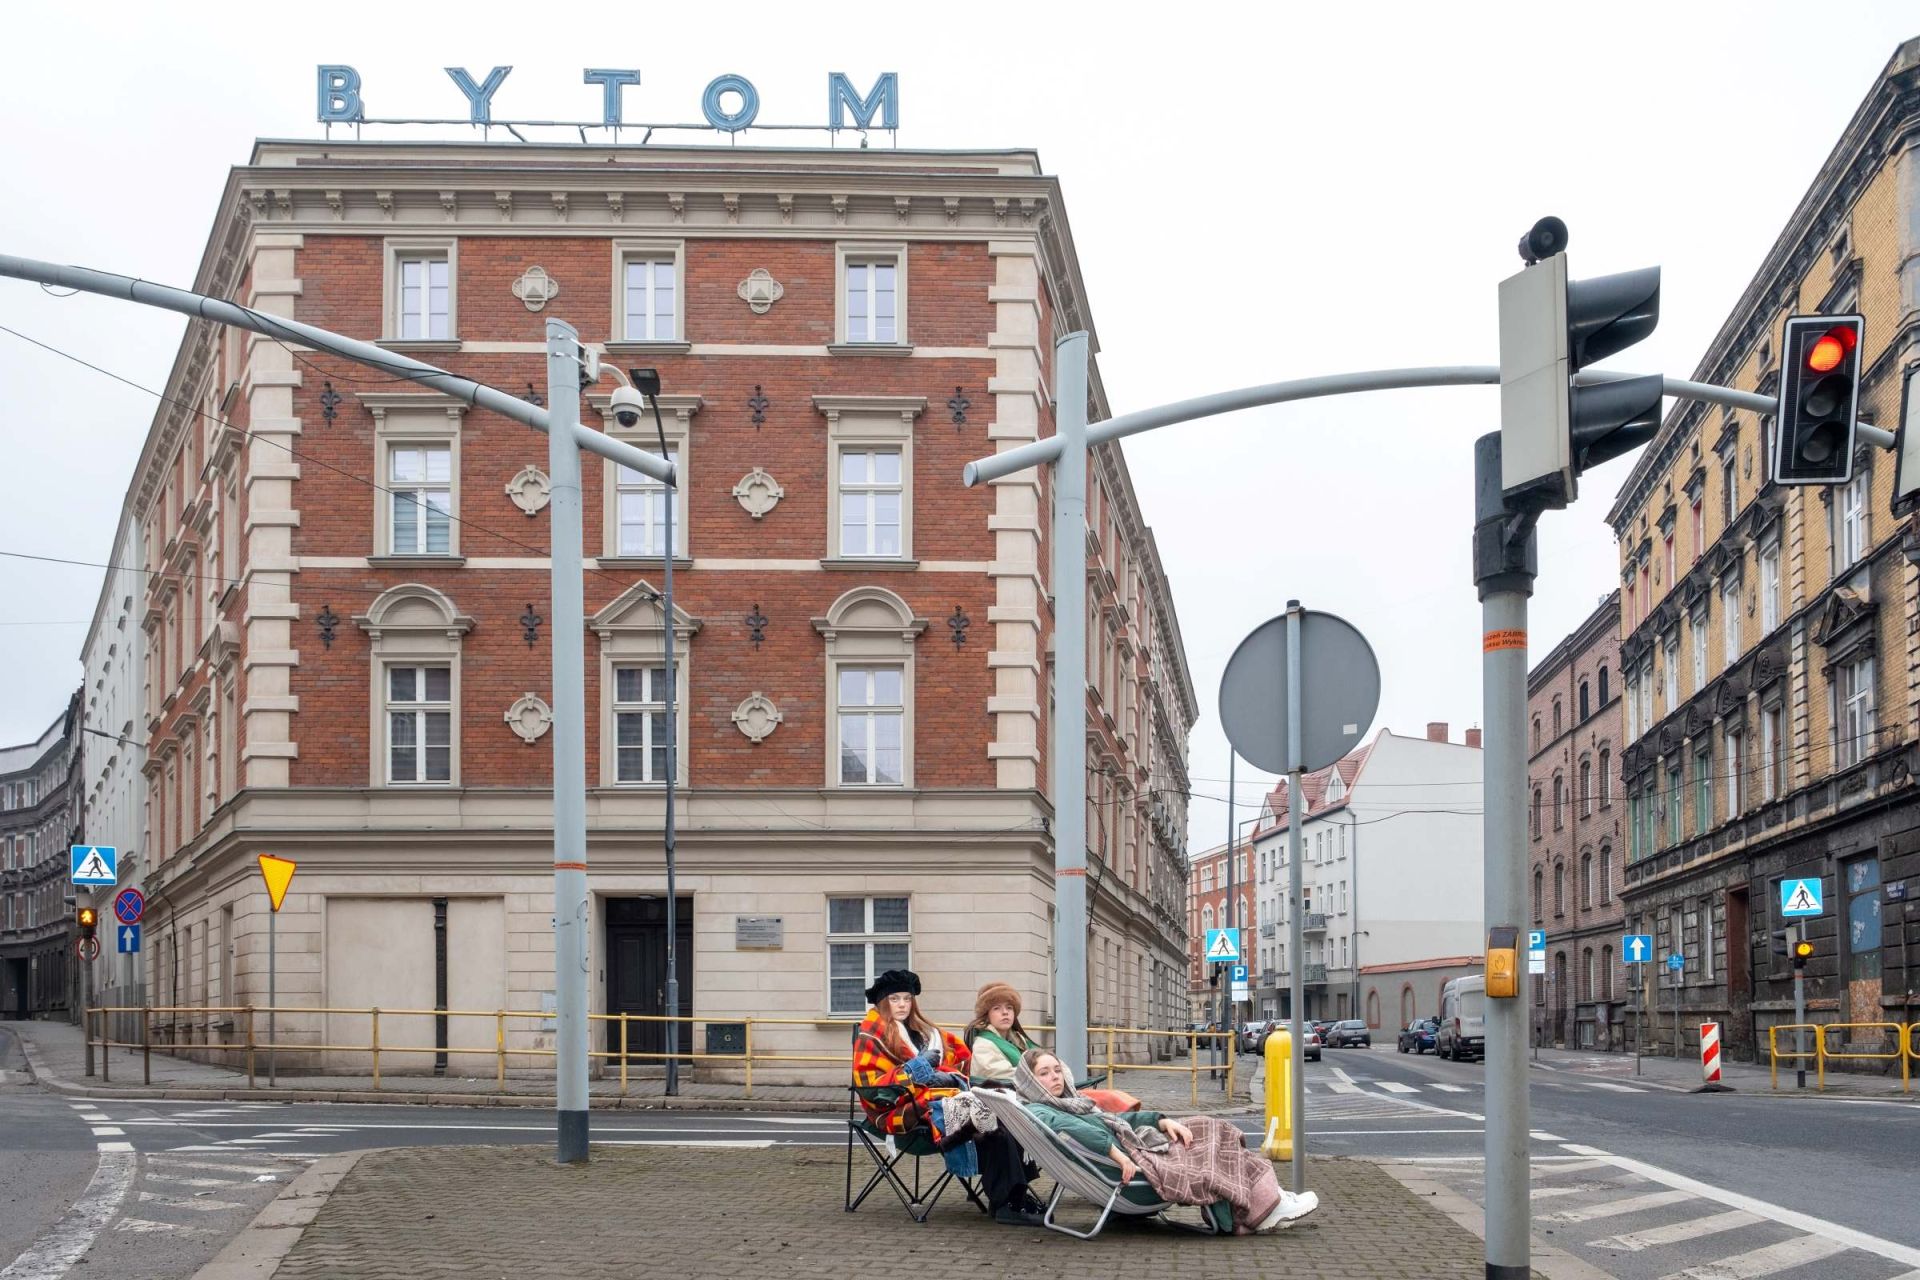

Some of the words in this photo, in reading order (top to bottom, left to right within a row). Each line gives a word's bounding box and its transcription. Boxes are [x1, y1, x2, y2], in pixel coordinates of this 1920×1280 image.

[317, 65, 899, 131] BYTOM
[1529, 932, 1541, 948] P
[1235, 967, 1244, 980] P
